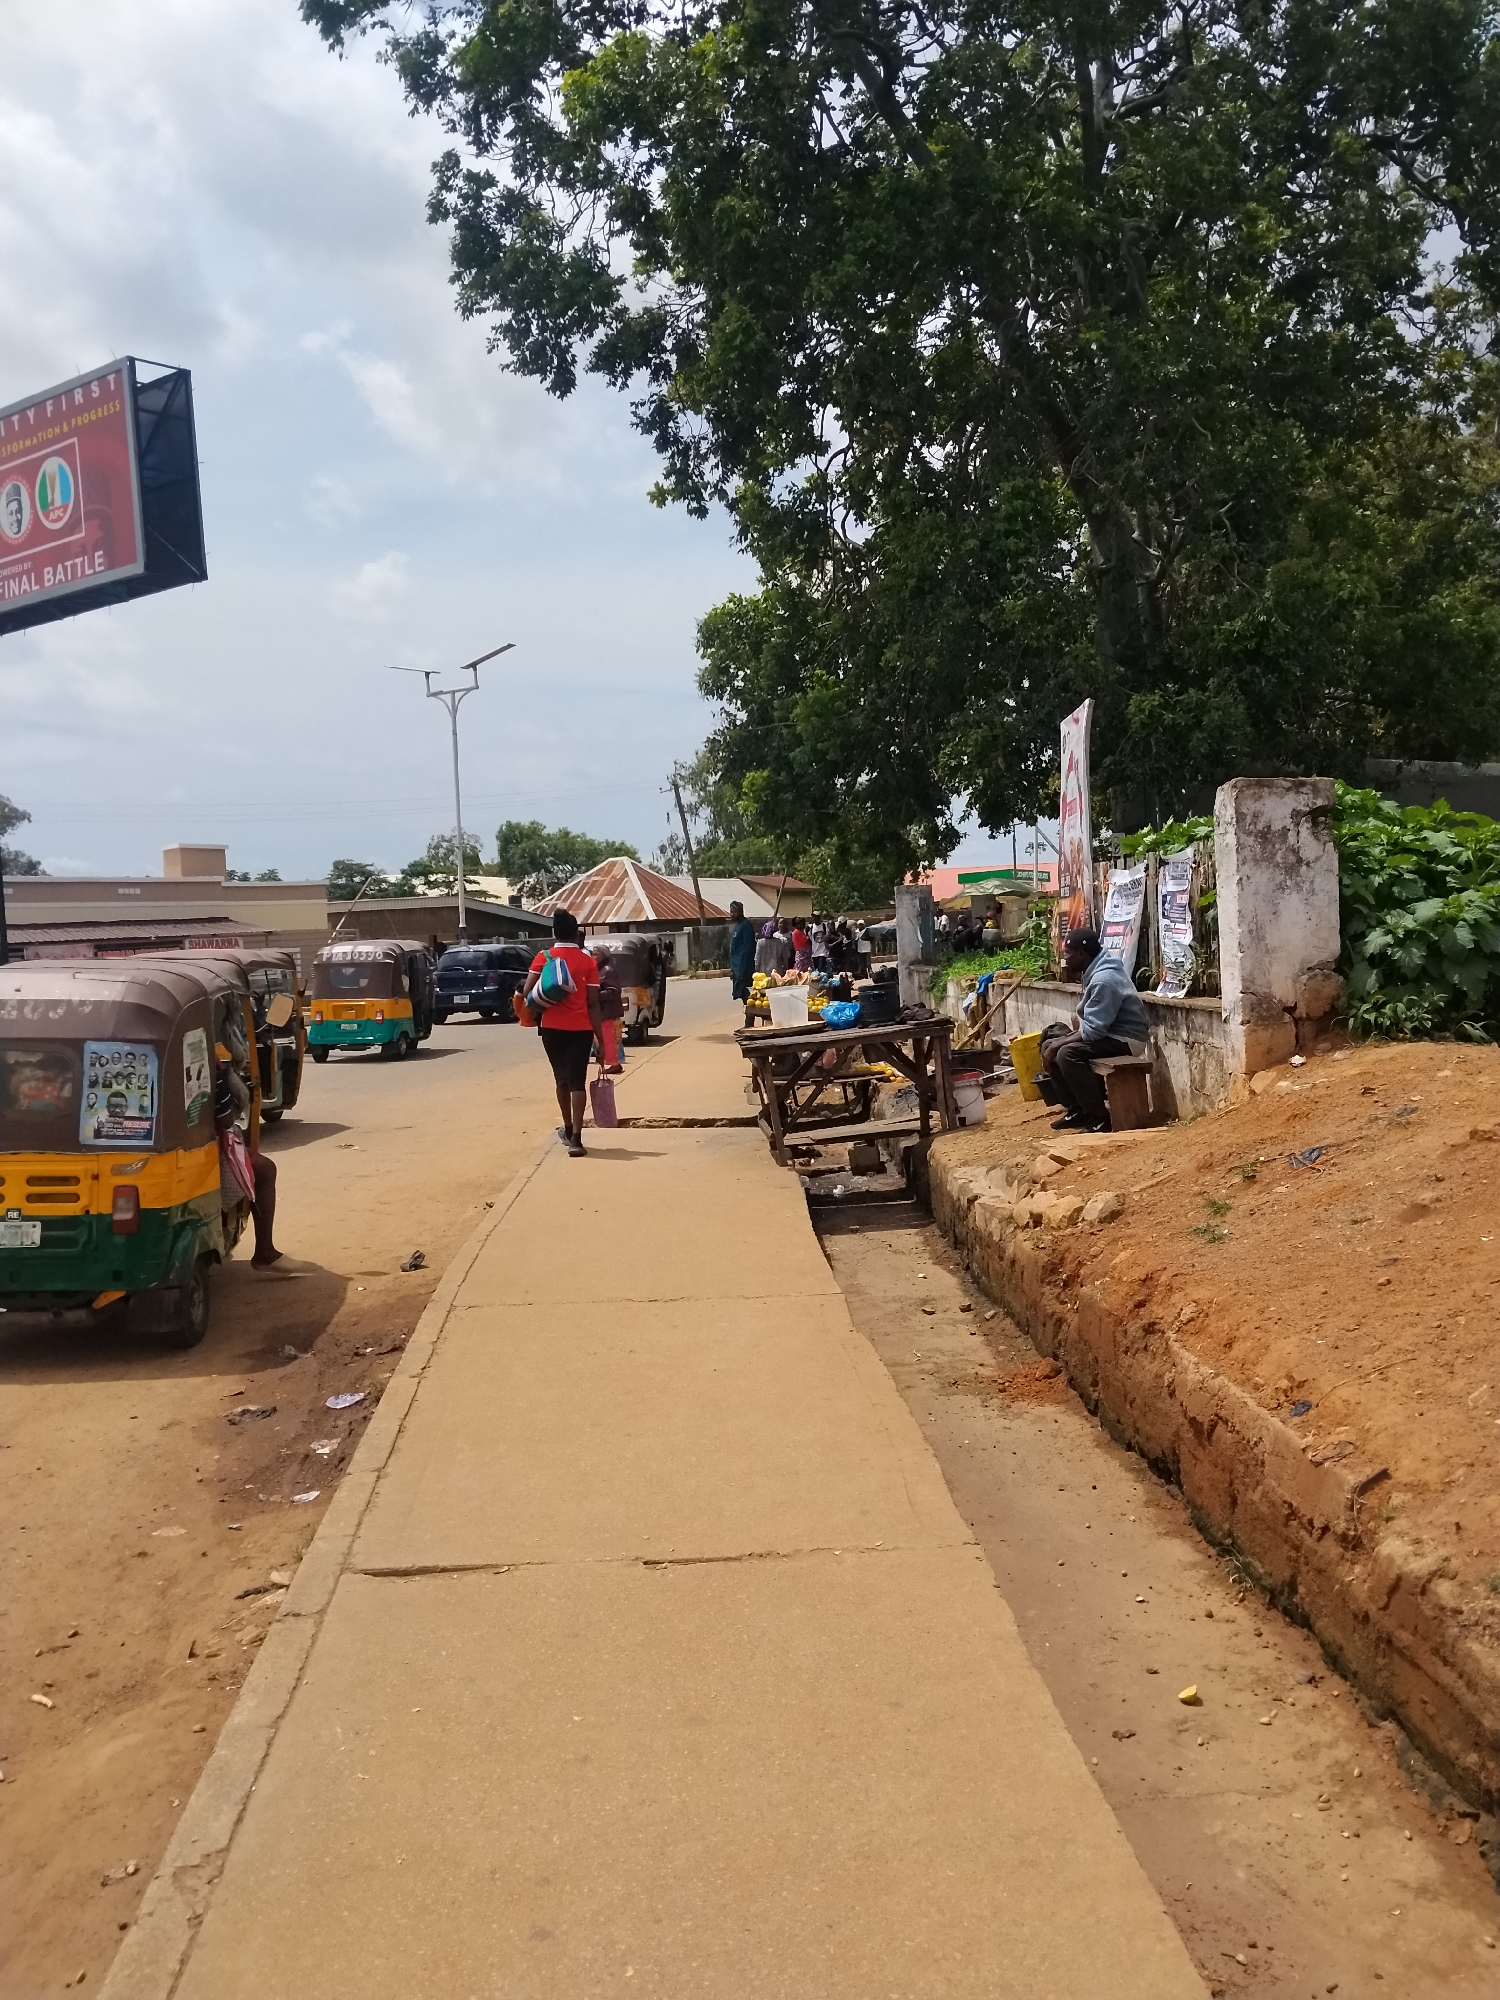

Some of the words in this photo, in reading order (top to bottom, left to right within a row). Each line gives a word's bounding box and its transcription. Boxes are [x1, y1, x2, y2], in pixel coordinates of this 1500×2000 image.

[46, 373, 116, 417] FIRST
[63, 421, 68, 432] &
[71, 400, 121, 428] PROGRESS
[48, 508, 65, 521] APC
[43, 550, 105, 587] BATTLE
[188, 938, 240, 949] SHAWARMA
